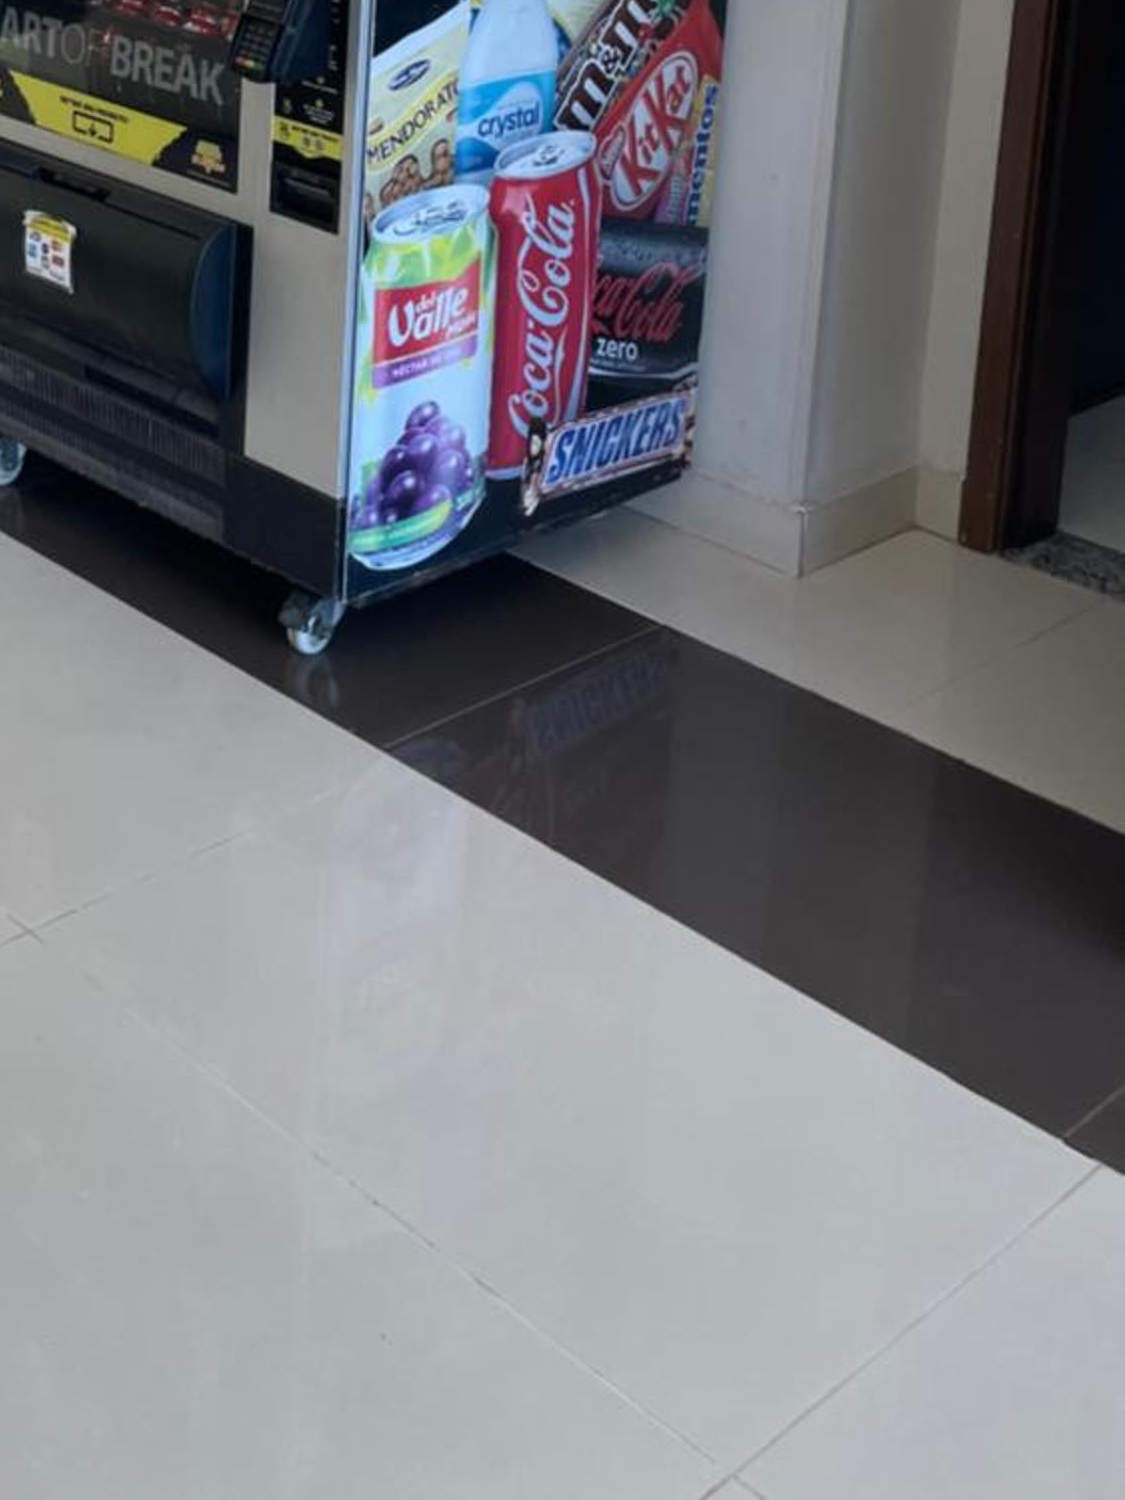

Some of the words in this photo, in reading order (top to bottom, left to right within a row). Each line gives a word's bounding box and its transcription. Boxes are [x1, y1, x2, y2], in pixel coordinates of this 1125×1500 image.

[478, 102, 540, 139] crystal
[507, 192, 576, 439] Coca-Cola
[596, 338, 638, 361] zero
[548, 400, 686, 484] SNICKERS
